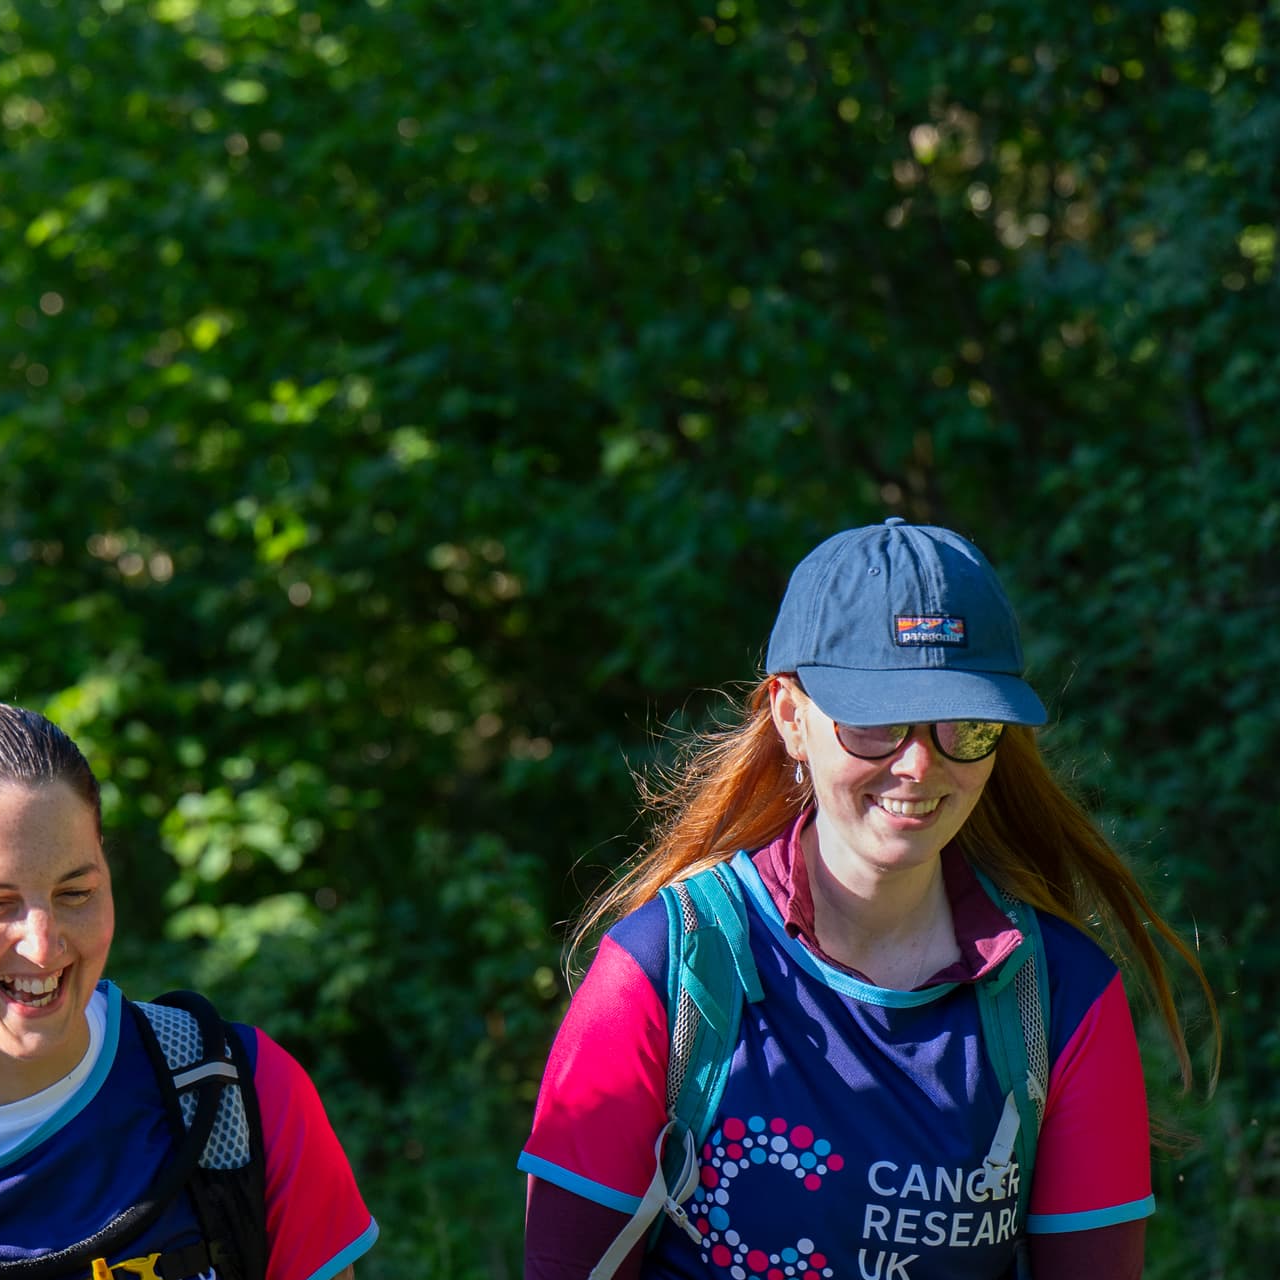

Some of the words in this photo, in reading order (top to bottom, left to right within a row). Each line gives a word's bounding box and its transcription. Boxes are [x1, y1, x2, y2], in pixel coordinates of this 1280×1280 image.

[903, 631, 961, 643] patagonia
[868, 1161, 1020, 1203] CANCR
[862, 1200, 1019, 1248] RESEARC
